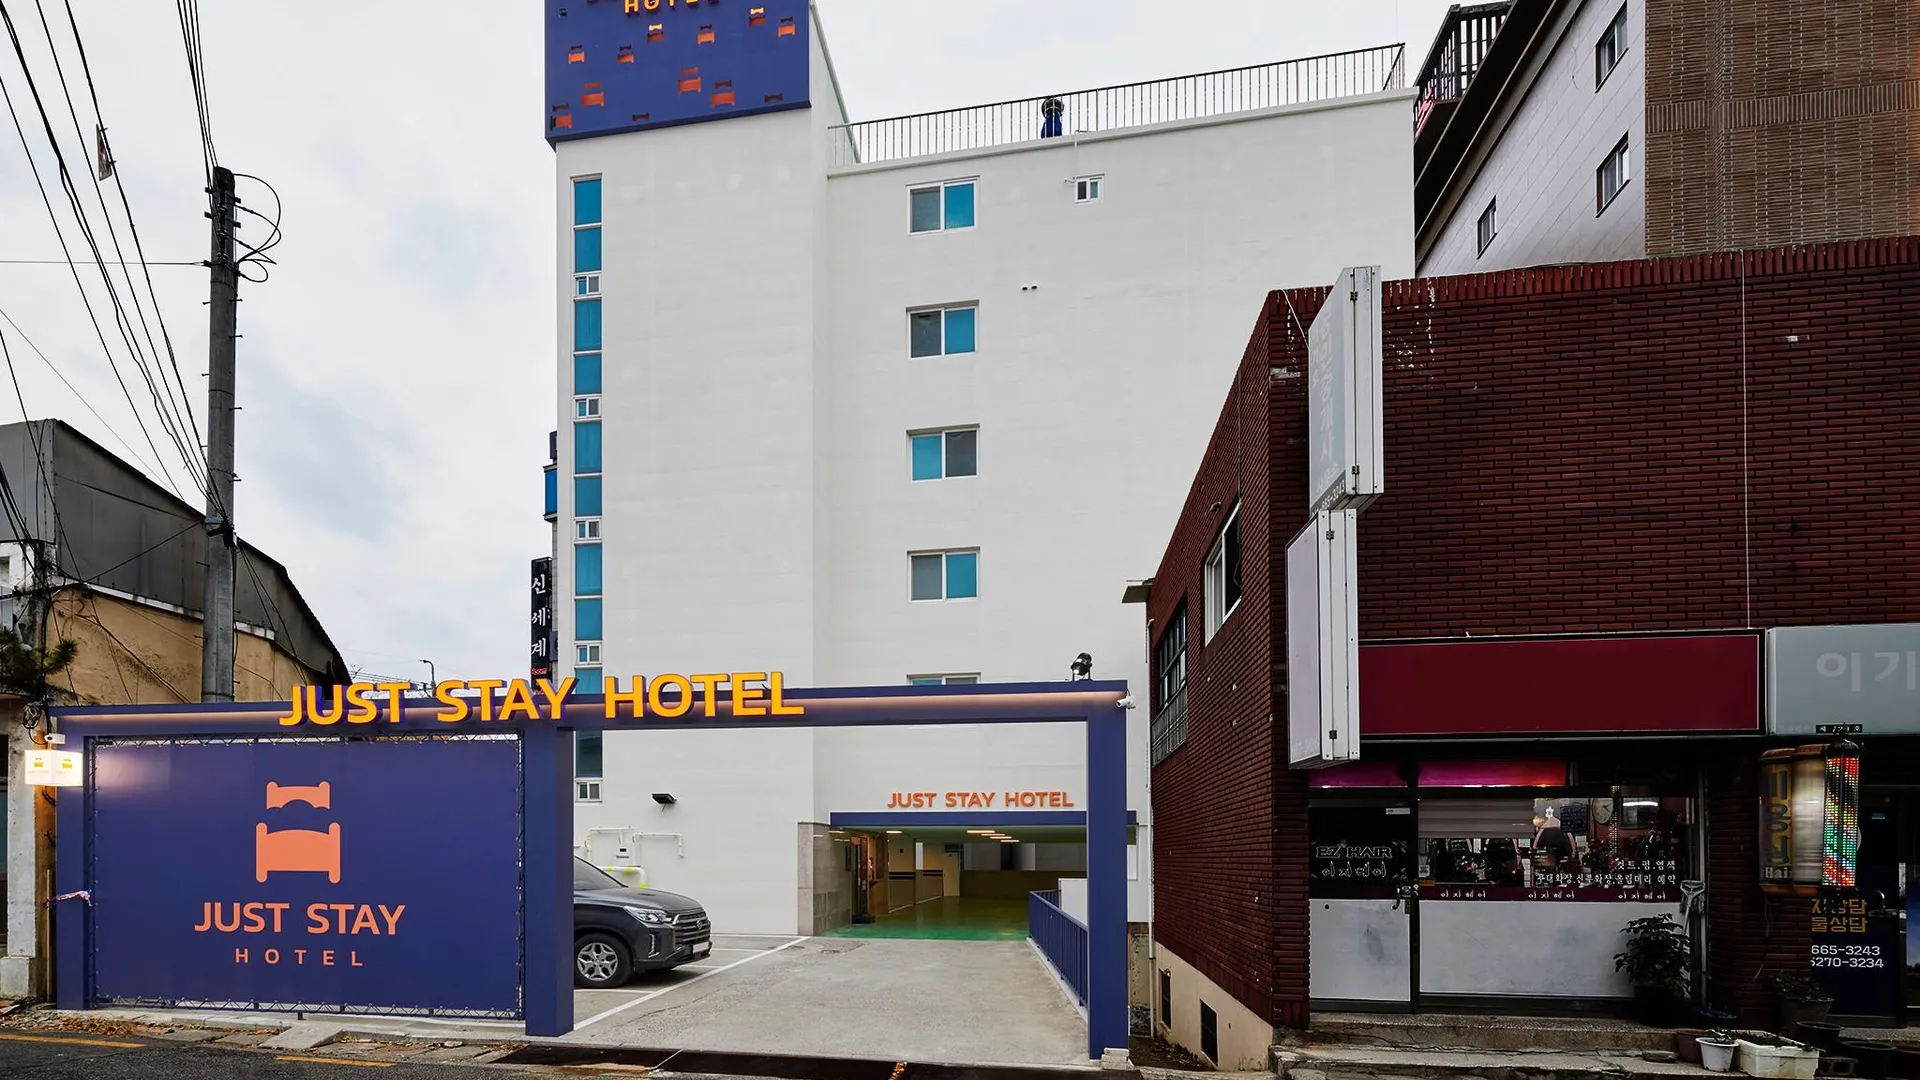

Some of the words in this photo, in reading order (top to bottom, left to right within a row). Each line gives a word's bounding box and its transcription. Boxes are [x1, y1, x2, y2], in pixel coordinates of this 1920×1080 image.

[531, 573, 547, 657] 신세계
[279, 683, 411, 727] JUST
[436, 678, 578, 722] STAY
[604, 671, 805, 719] HOTEL
[887, 793, 937, 808] JUST
[945, 792, 995, 807] STAY
[1005, 791, 1074, 807] HOTEL
[1346, 846, 1393, 858] HAIR
[1321, 860, 1386, 877] 이지헤어
[194, 902, 290, 932] JUST
[306, 903, 406, 935] STAY
[235, 948, 363, 966] HOTEL
[1811, 944, 1880, 956] 665-3243
